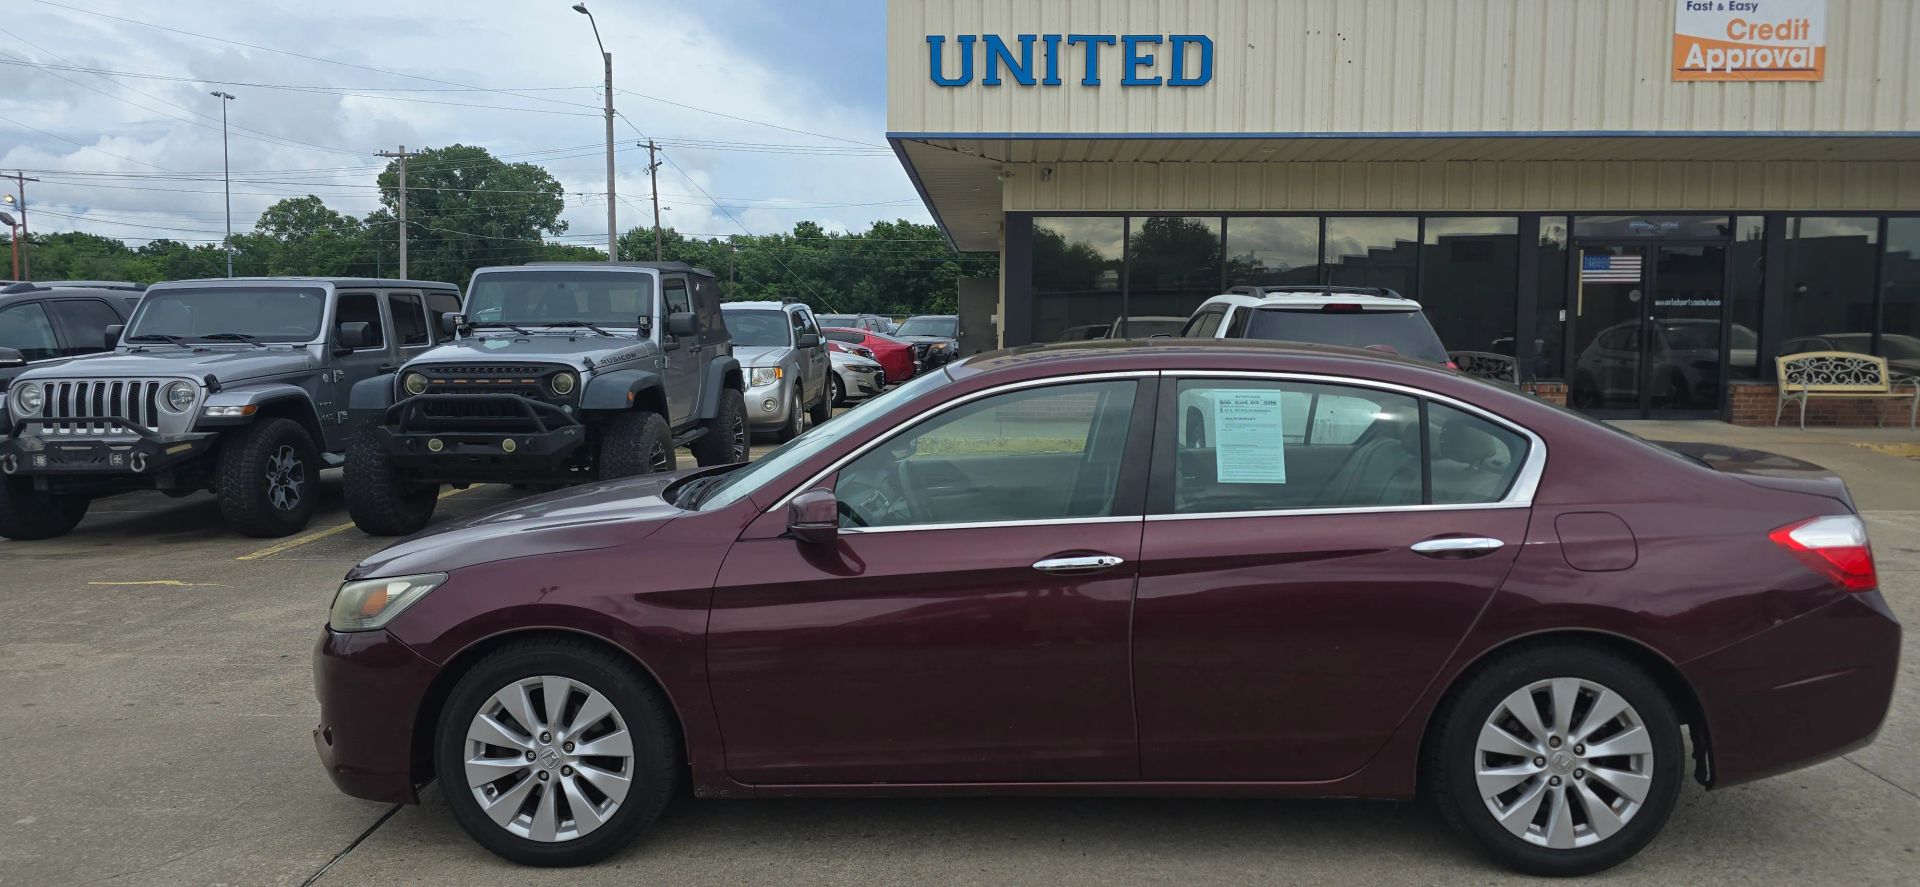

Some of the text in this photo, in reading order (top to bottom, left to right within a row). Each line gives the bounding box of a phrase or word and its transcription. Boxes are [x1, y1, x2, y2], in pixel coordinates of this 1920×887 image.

[1686, 1, 1758, 13] Fast & Easy
[1726, 18, 1810, 41] Credit
[926, 34, 1214, 87] UNITED
[1684, 43, 1816, 73] Approval
[600, 353, 637, 365] RUBICON
